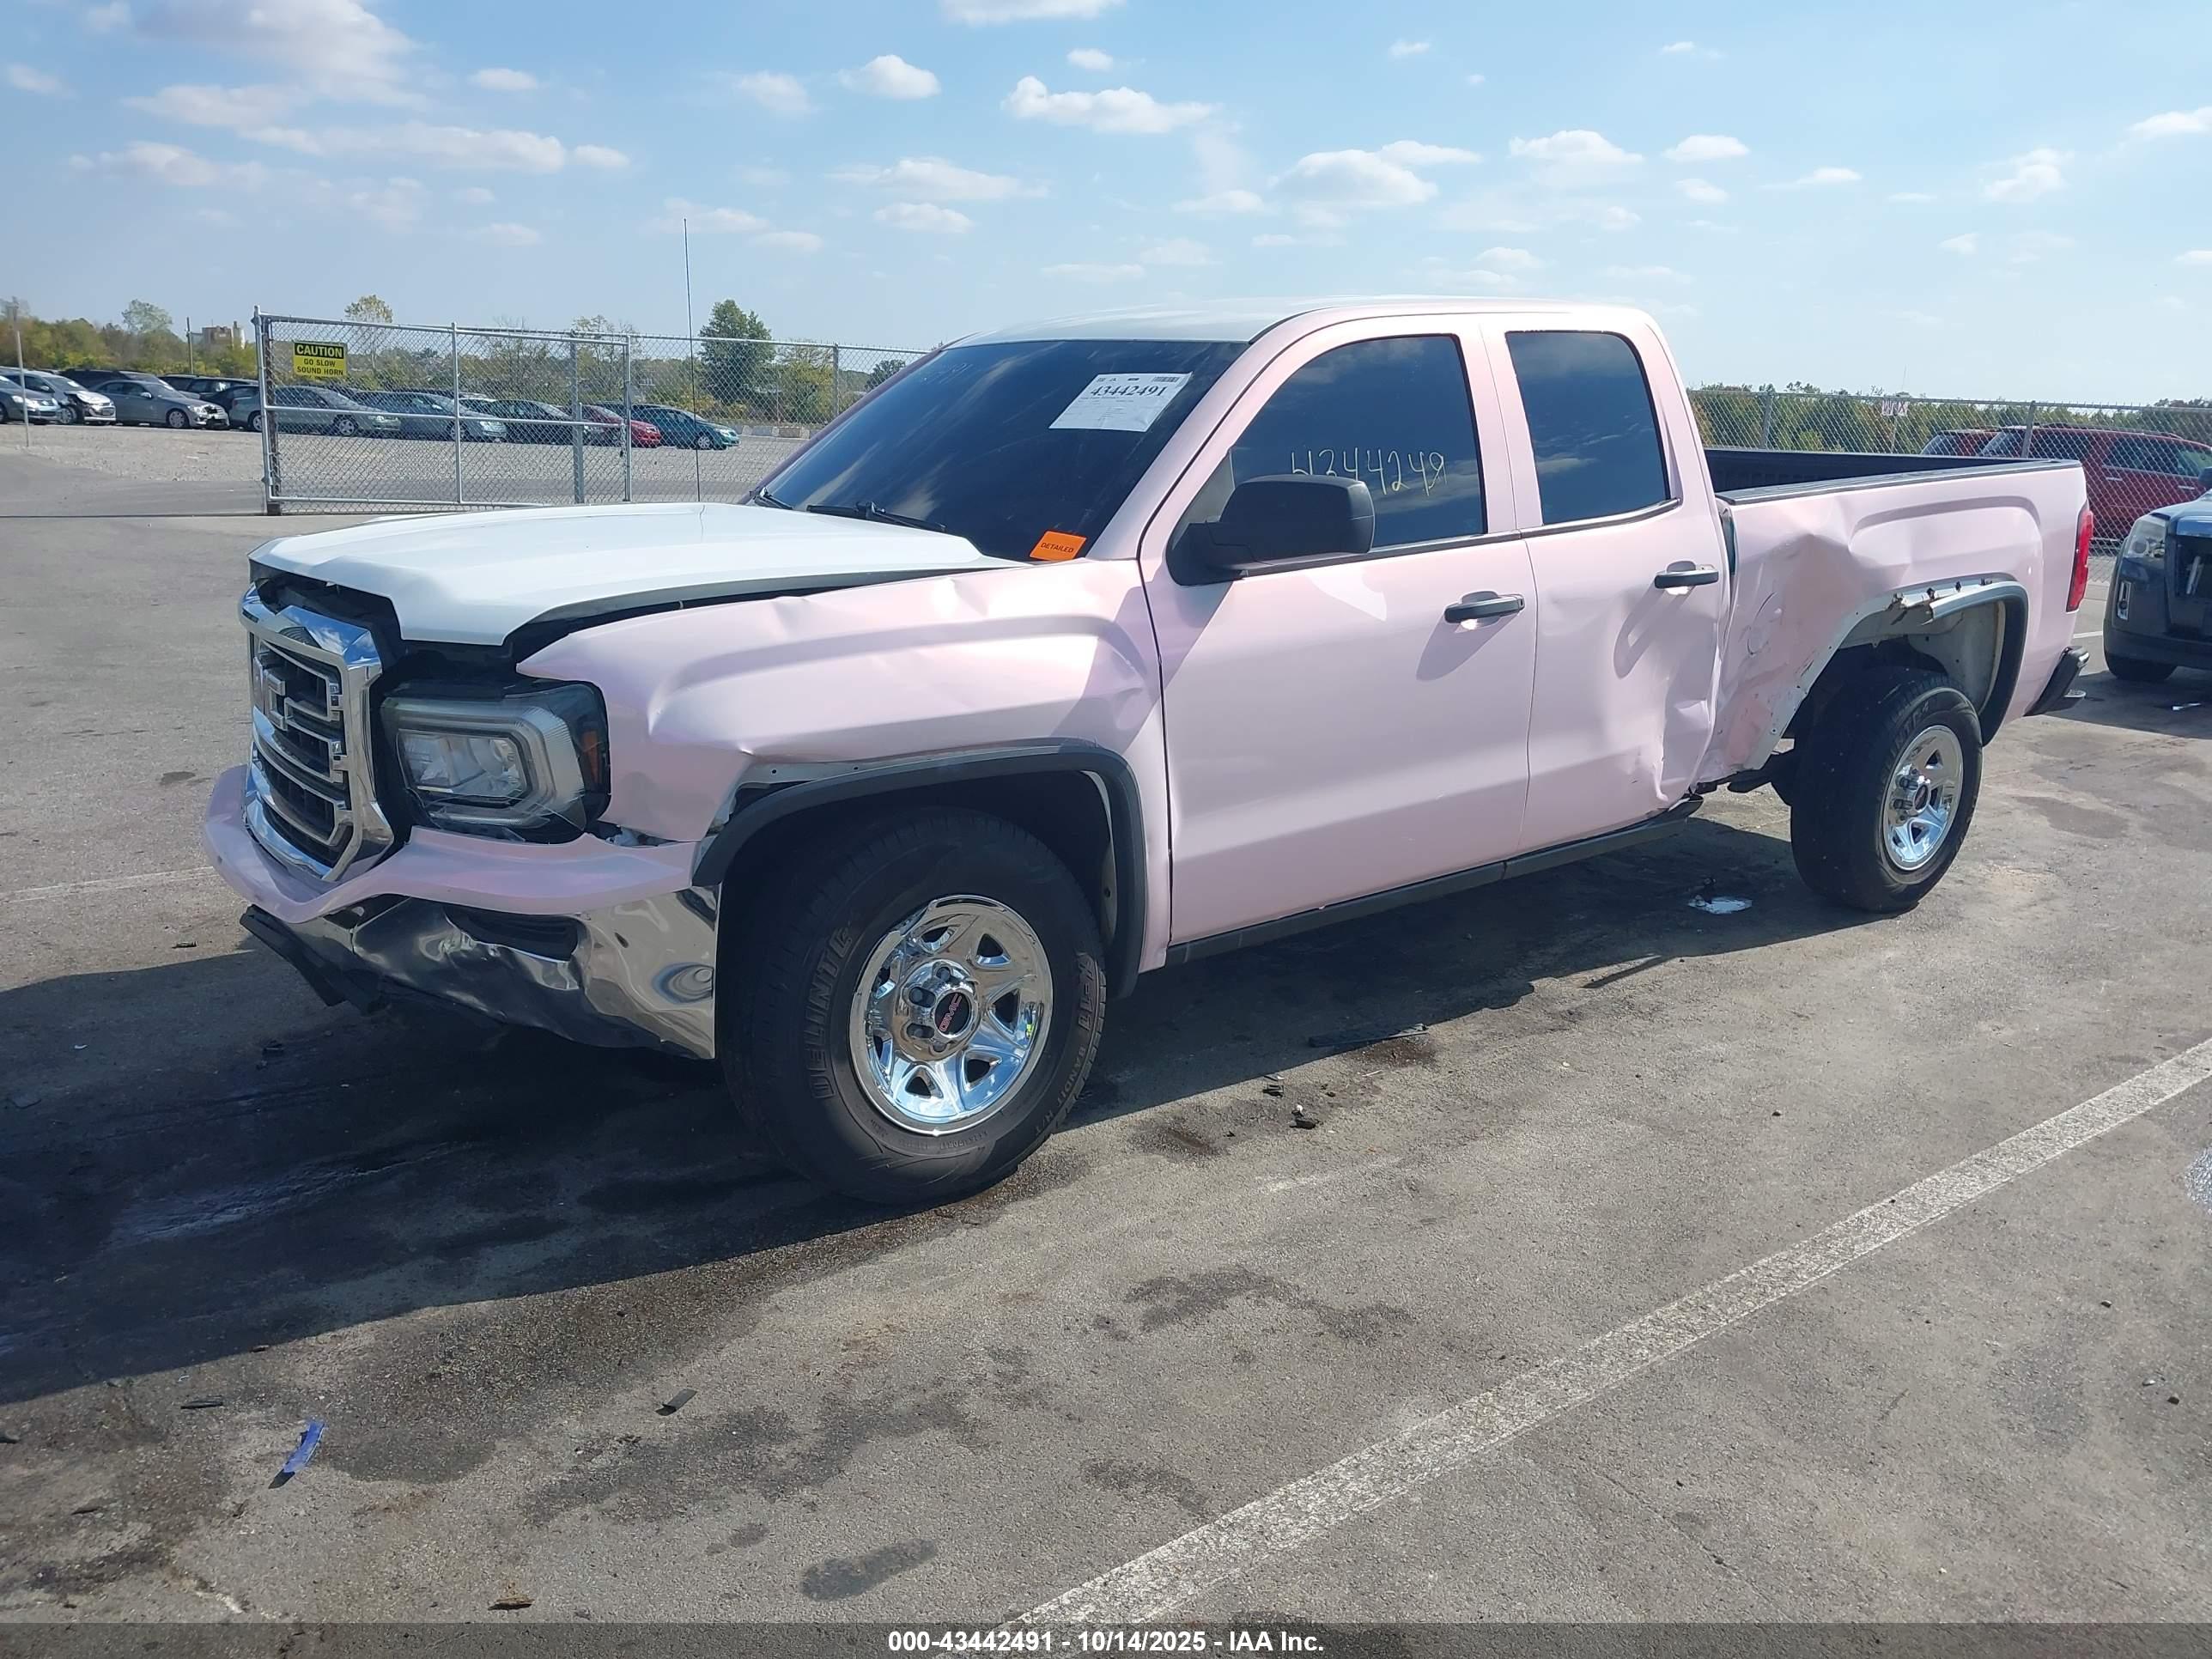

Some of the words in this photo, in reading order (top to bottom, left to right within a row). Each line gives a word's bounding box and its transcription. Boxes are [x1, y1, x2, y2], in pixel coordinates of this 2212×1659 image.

[296, 344, 343, 357] CAUTION
[296, 366, 322, 374] SOUND
[1090, 386, 1168, 397] 43442491
[1040, 542, 1075, 553] DETAILED
